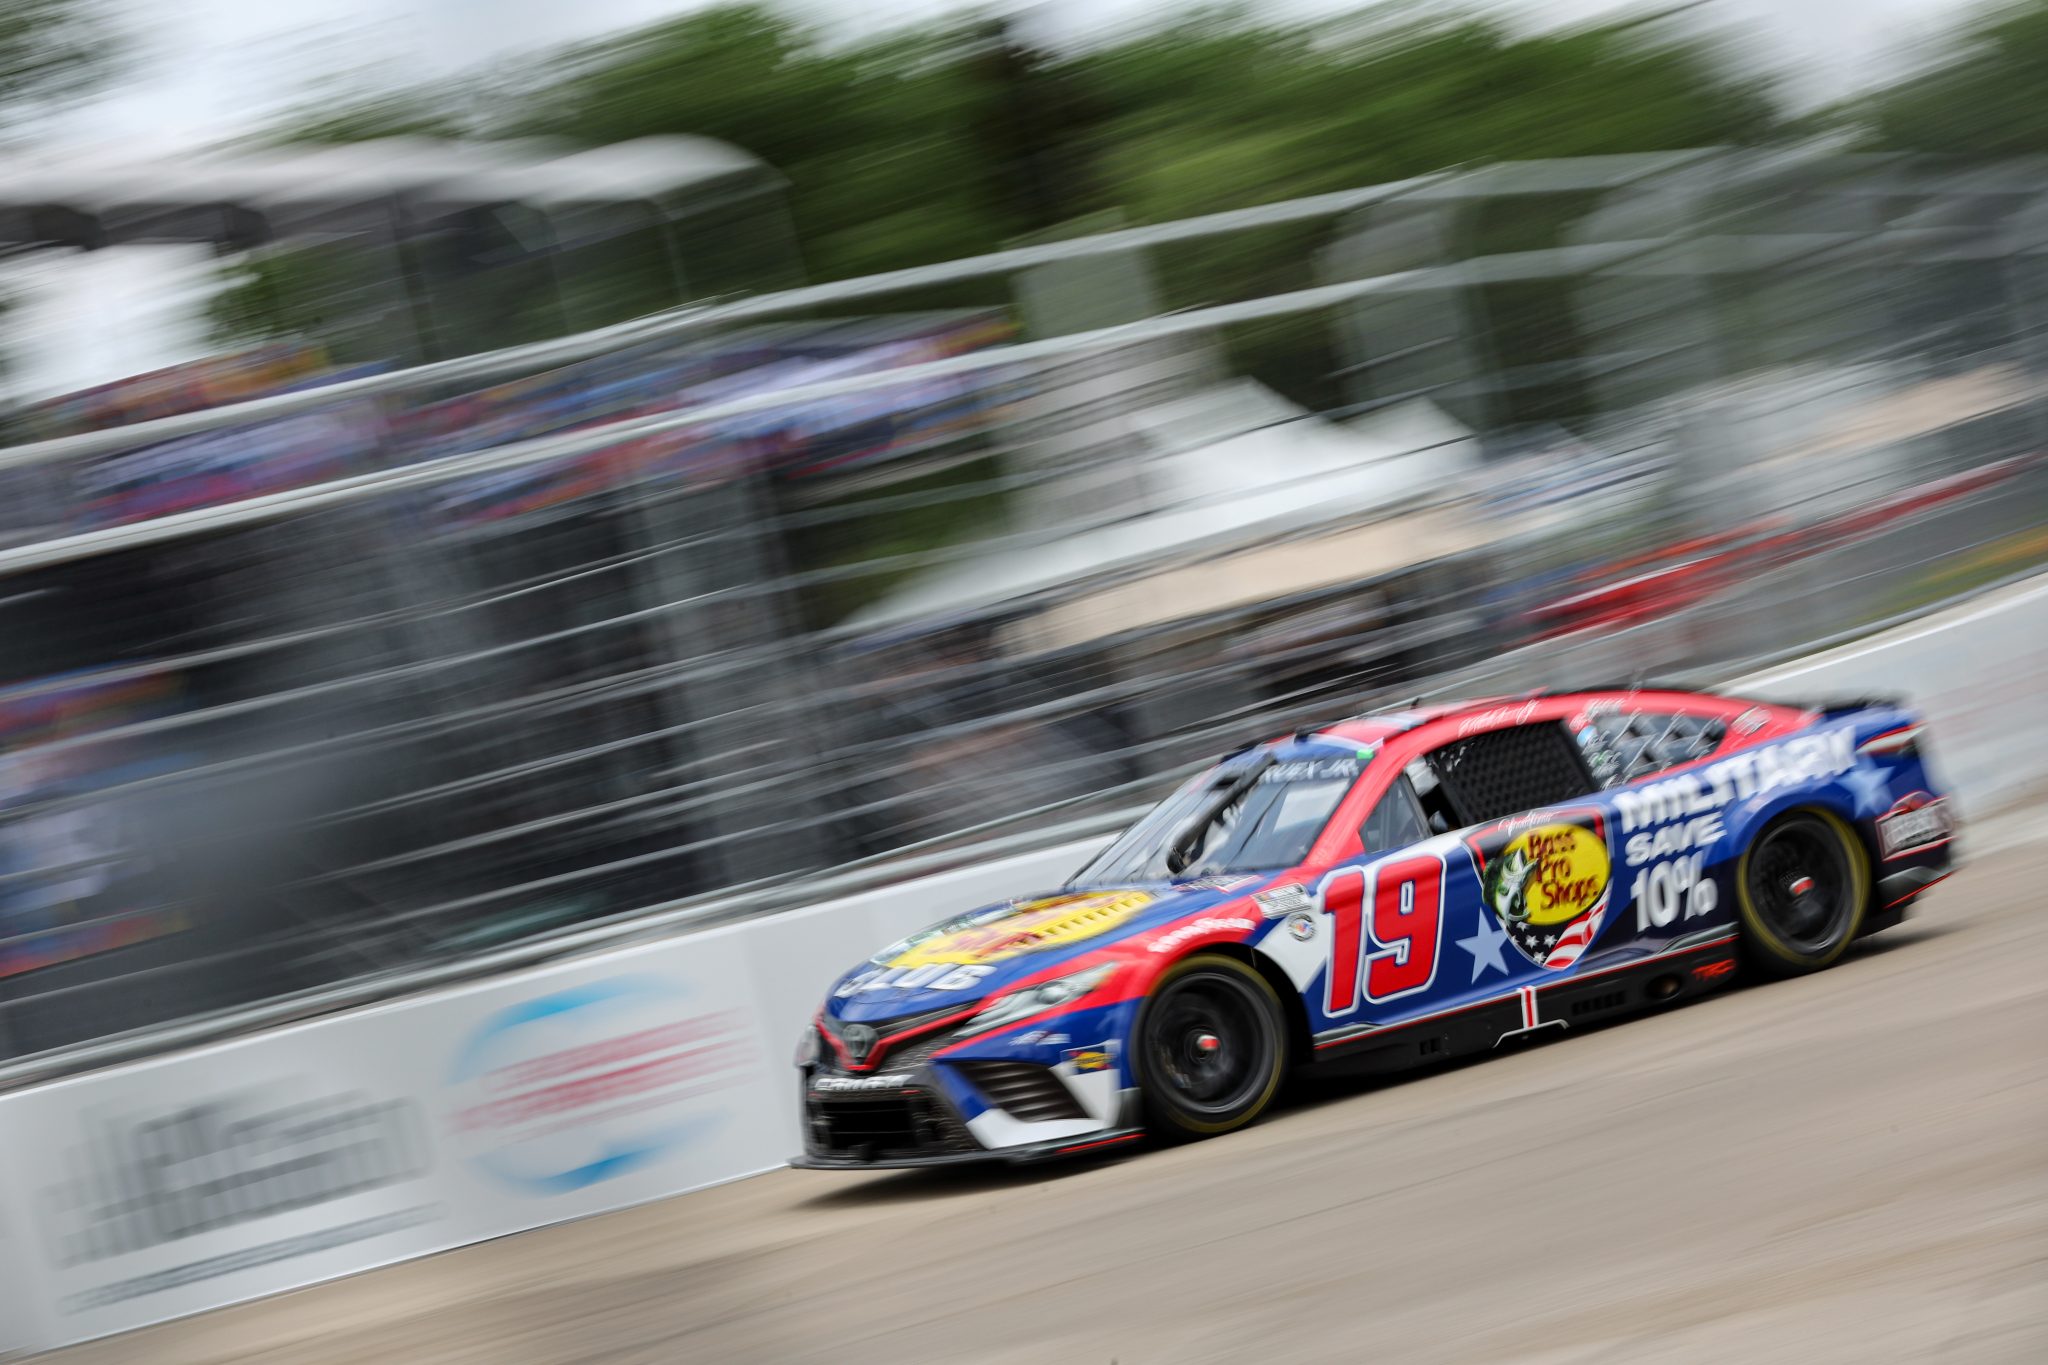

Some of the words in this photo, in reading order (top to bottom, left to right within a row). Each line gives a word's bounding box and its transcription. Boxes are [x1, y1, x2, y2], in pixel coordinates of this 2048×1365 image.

[1527, 829, 1577, 861] Bass
[1624, 811, 1728, 867] SAVE
[1535, 855, 1571, 883] Pro
[1630, 850, 1719, 933] 10%
[1540, 875, 1599, 911] Shops
[1319, 853, 1448, 1018] 19
